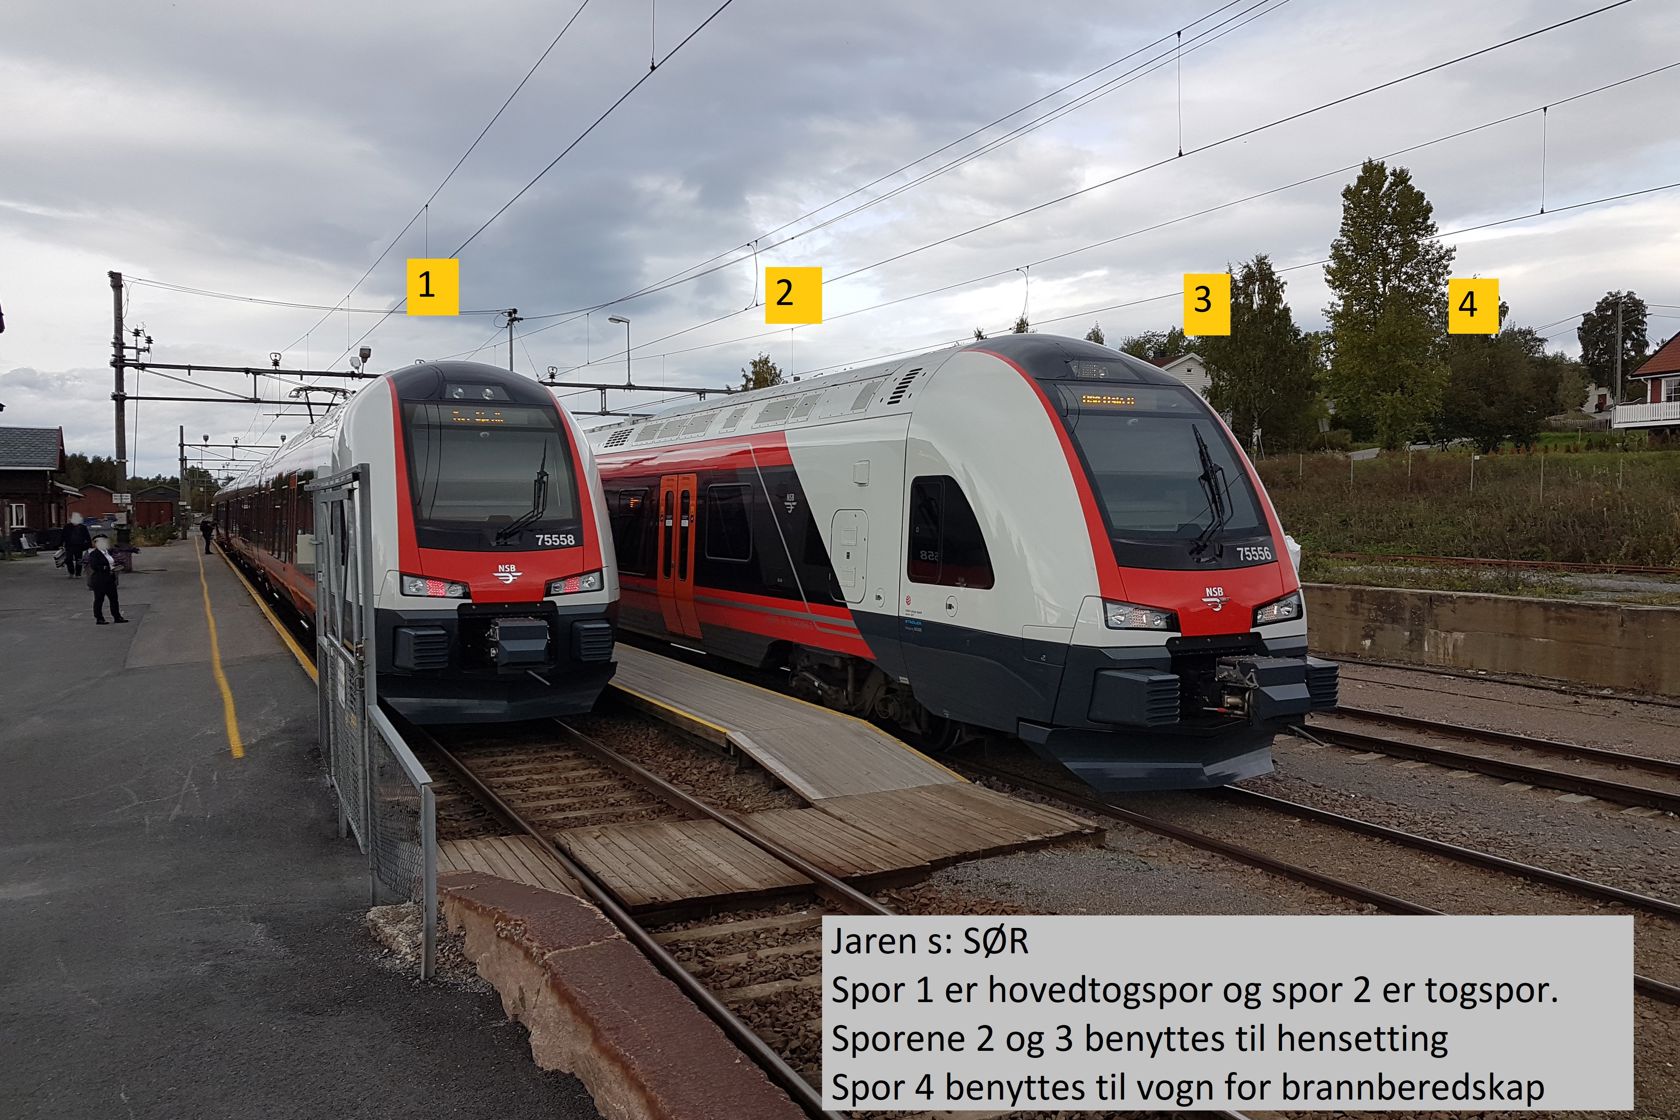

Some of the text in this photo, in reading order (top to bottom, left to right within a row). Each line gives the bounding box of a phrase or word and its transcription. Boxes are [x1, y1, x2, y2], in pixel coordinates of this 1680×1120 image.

[535, 534, 576, 547] 75558
[1236, 546, 1272, 561] 75556
[498, 564, 516, 572] NSB
[1205, 587, 1224, 597] NSB
